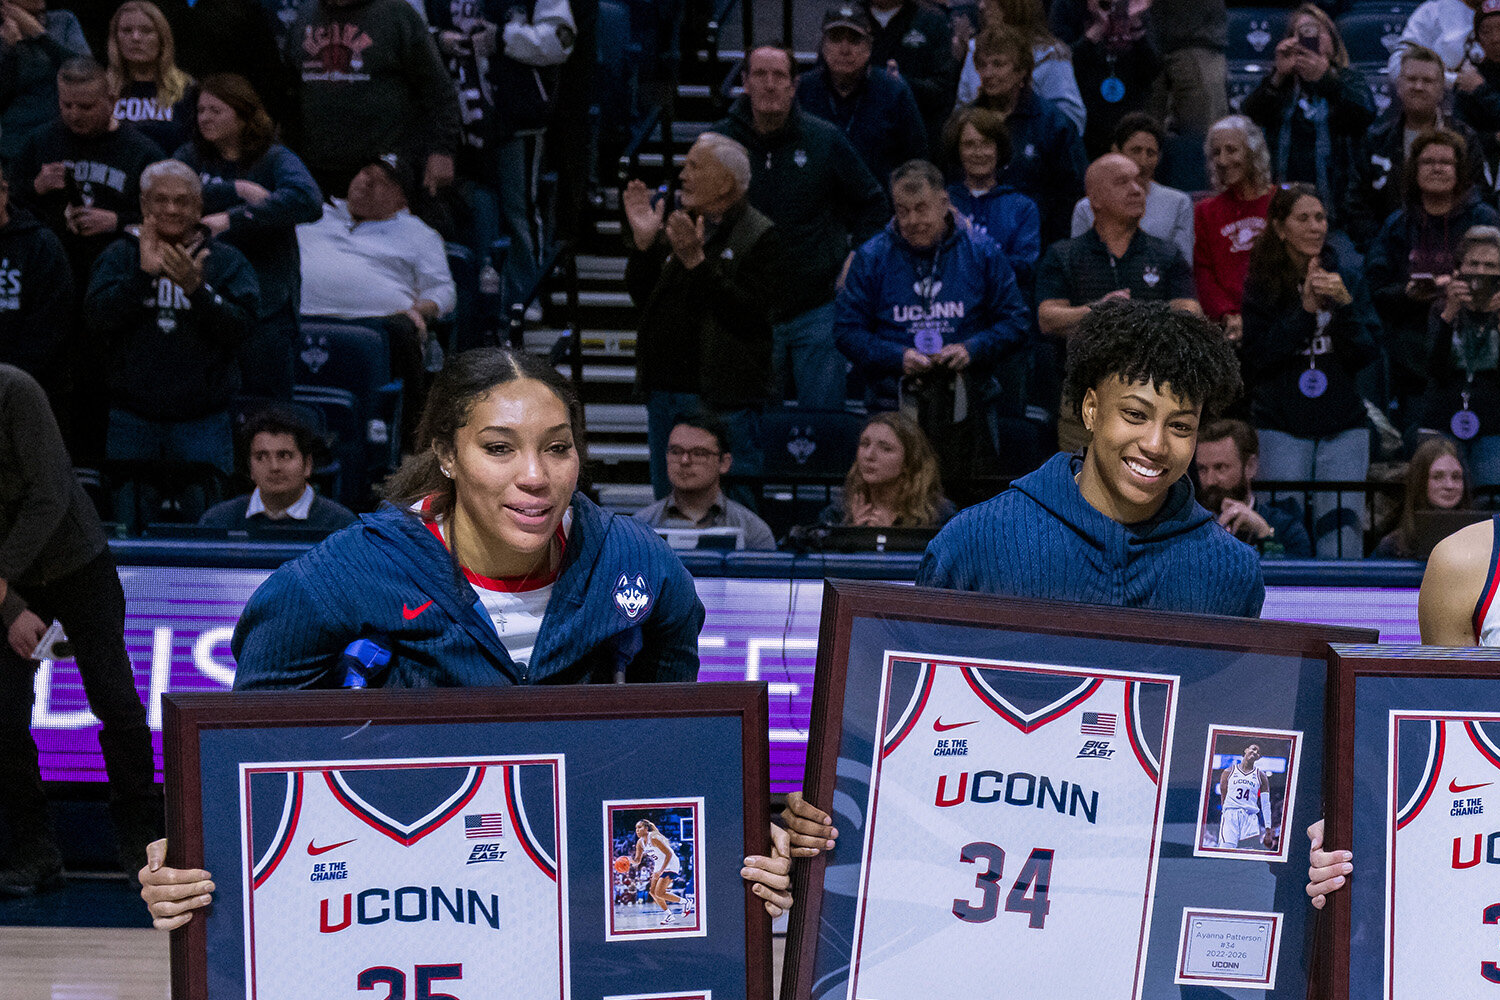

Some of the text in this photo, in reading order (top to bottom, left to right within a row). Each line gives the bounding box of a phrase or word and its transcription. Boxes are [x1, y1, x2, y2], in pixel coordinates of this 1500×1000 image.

[64, 160, 127, 193] ONN
[937, 739, 968, 748] BE THE
[1085, 740, 1111, 749] BIG
[933, 747, 968, 756] CHANGE
[1079, 748, 1116, 757] EAST
[934, 770, 1099, 824] UCONN
[1235, 788, 1250, 801] 34
[1453, 797, 1482, 808] BE THE
[1450, 805, 1484, 816] CHANGE
[473, 843, 501, 853] BIG
[468, 850, 507, 860] EAST
[314, 861, 347, 872] BE THE
[310, 871, 348, 881] CHANGE
[952, 841, 1055, 930] 34
[319, 886, 500, 934] UCONN
[1196, 932, 1262, 942] Ayanna Patterson
[1206, 950, 1247, 959] 2022-2026
[1212, 961, 1240, 969] UCONN
